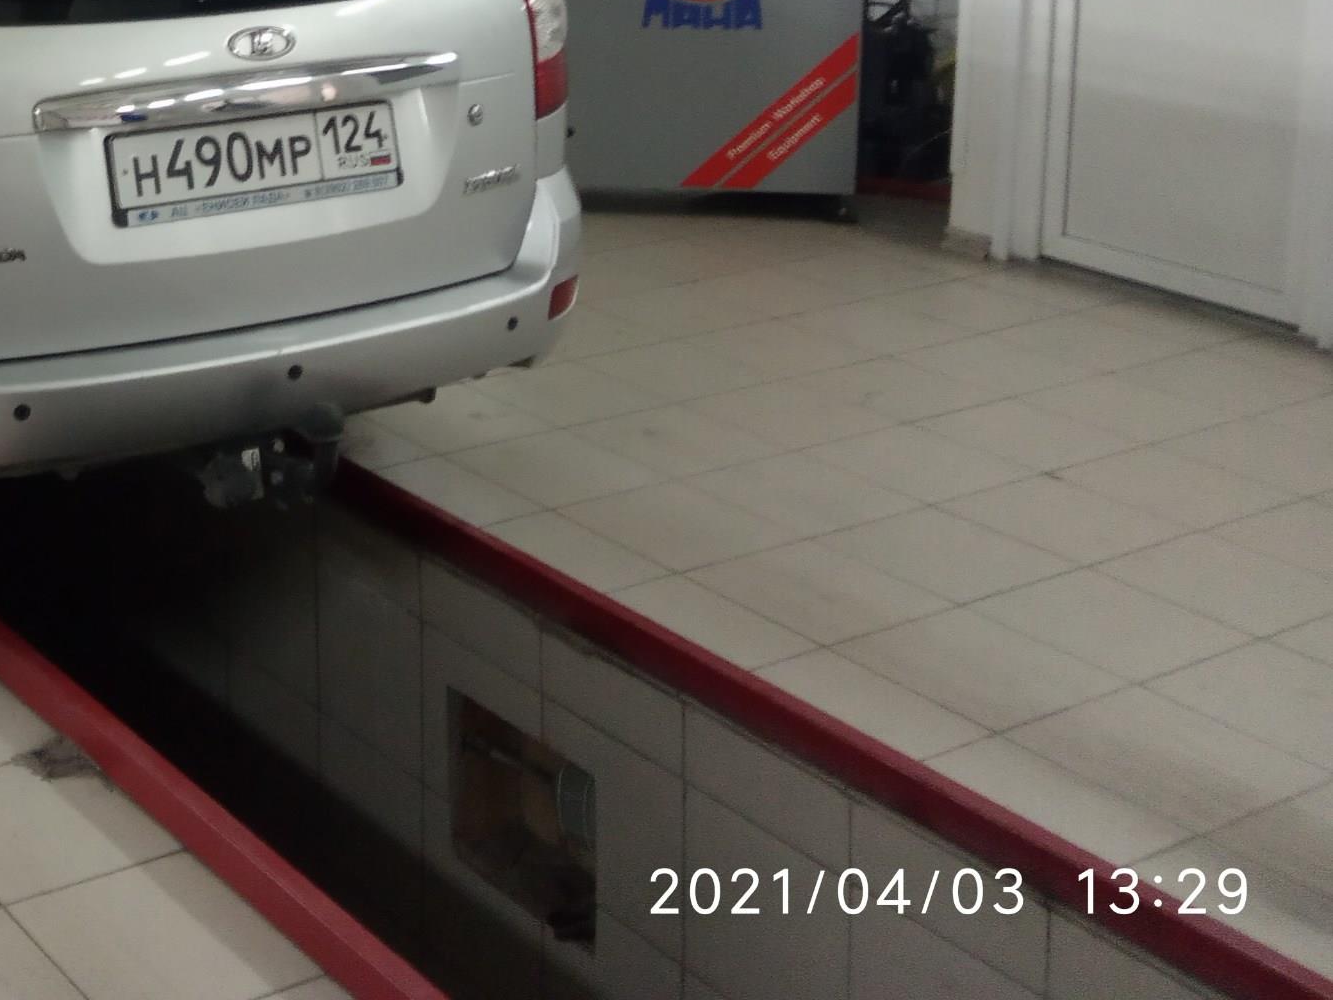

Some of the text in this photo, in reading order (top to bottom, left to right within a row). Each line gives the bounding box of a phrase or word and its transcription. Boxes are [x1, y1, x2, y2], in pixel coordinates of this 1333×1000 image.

[322, 111, 384, 155] 124
[768, 113, 821, 161] Equipment
[335, 154, 369, 168] RUS
